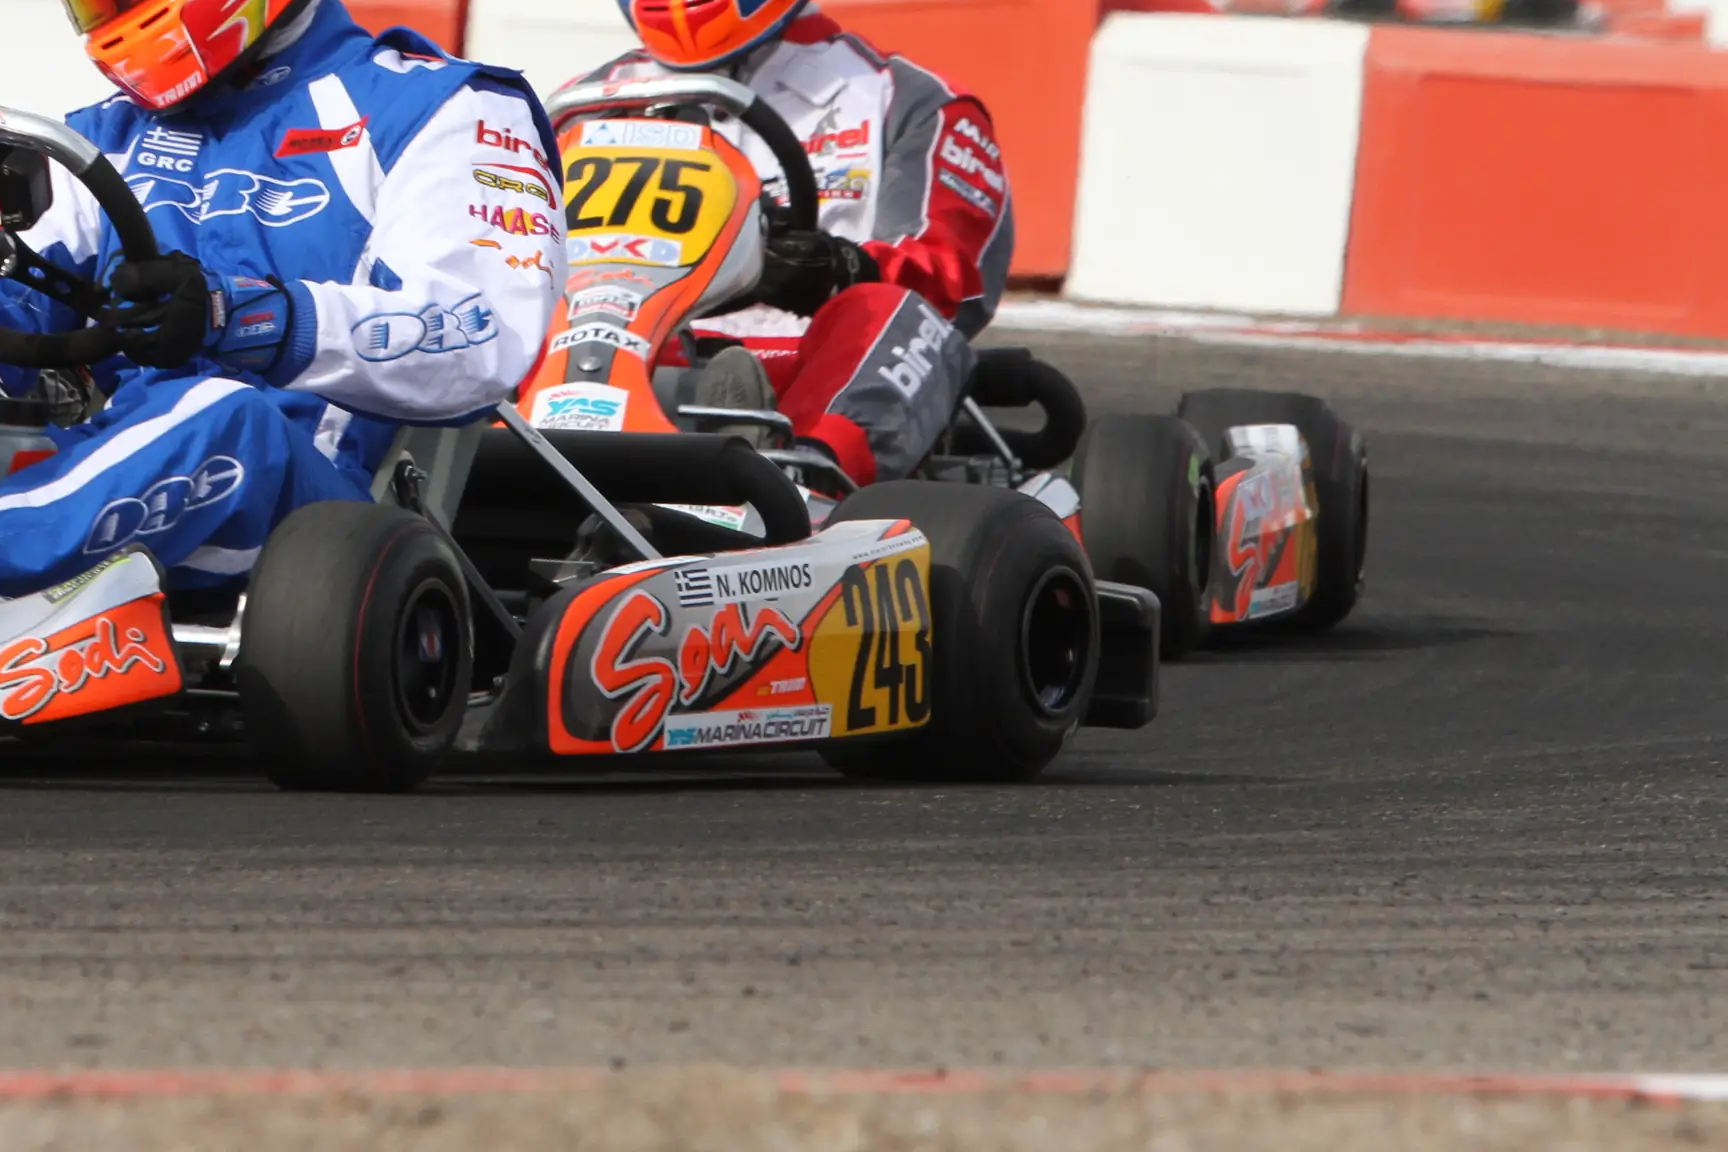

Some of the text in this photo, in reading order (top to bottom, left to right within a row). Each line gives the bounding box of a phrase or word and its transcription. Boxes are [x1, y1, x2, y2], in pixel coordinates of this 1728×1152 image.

[136, 151, 194, 173] GRC
[472, 168, 549, 202] CRG
[565, 156, 712, 235] 275
[553, 327, 641, 351] ROTAX
[877, 303, 955, 399] birel
[547, 397, 621, 417] YAS
[716, 563, 812, 599] N. KOMNOS
[841, 558, 933, 732] 243
